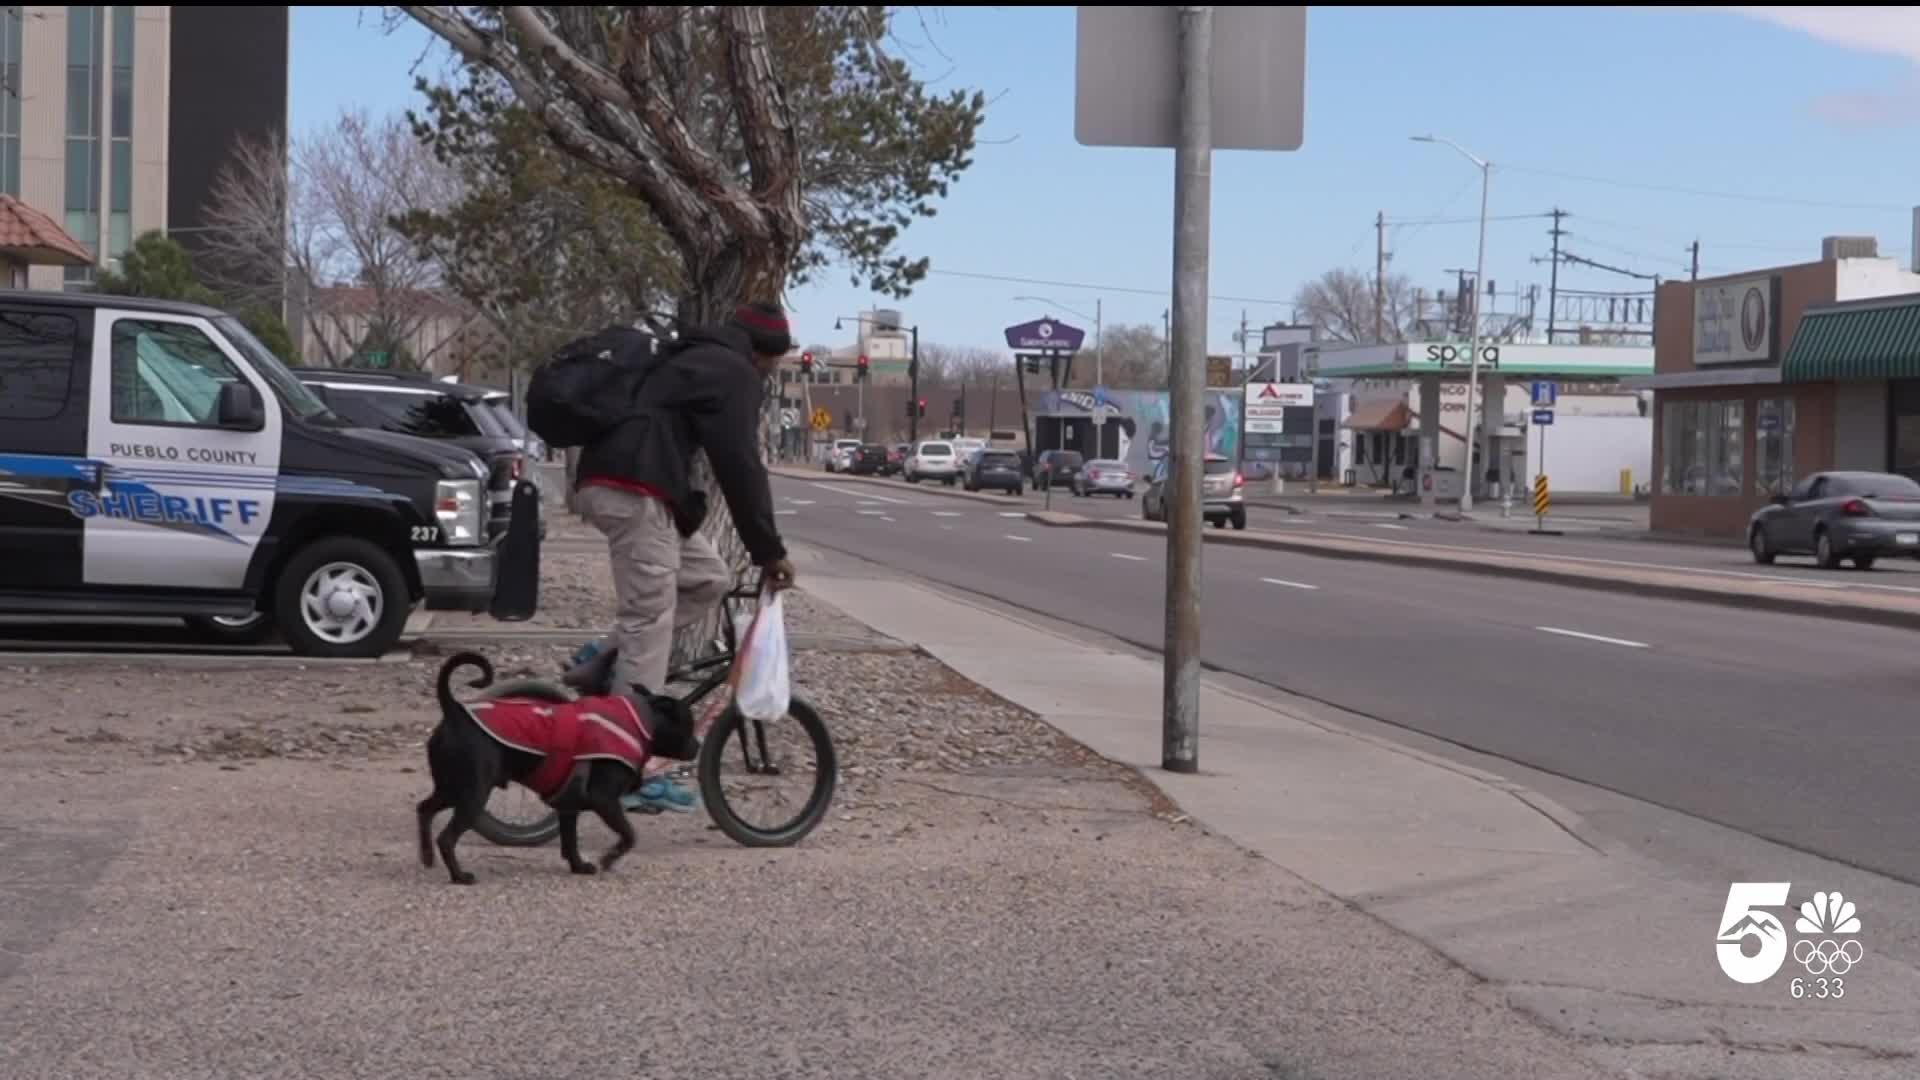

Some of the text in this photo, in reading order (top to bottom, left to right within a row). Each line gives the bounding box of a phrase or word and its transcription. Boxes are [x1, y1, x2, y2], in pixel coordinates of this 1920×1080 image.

[109, 442, 257, 465] PUEBLO COUNTY
[67, 488, 260, 526] SHERIFF
[410, 525, 440, 542] 237
